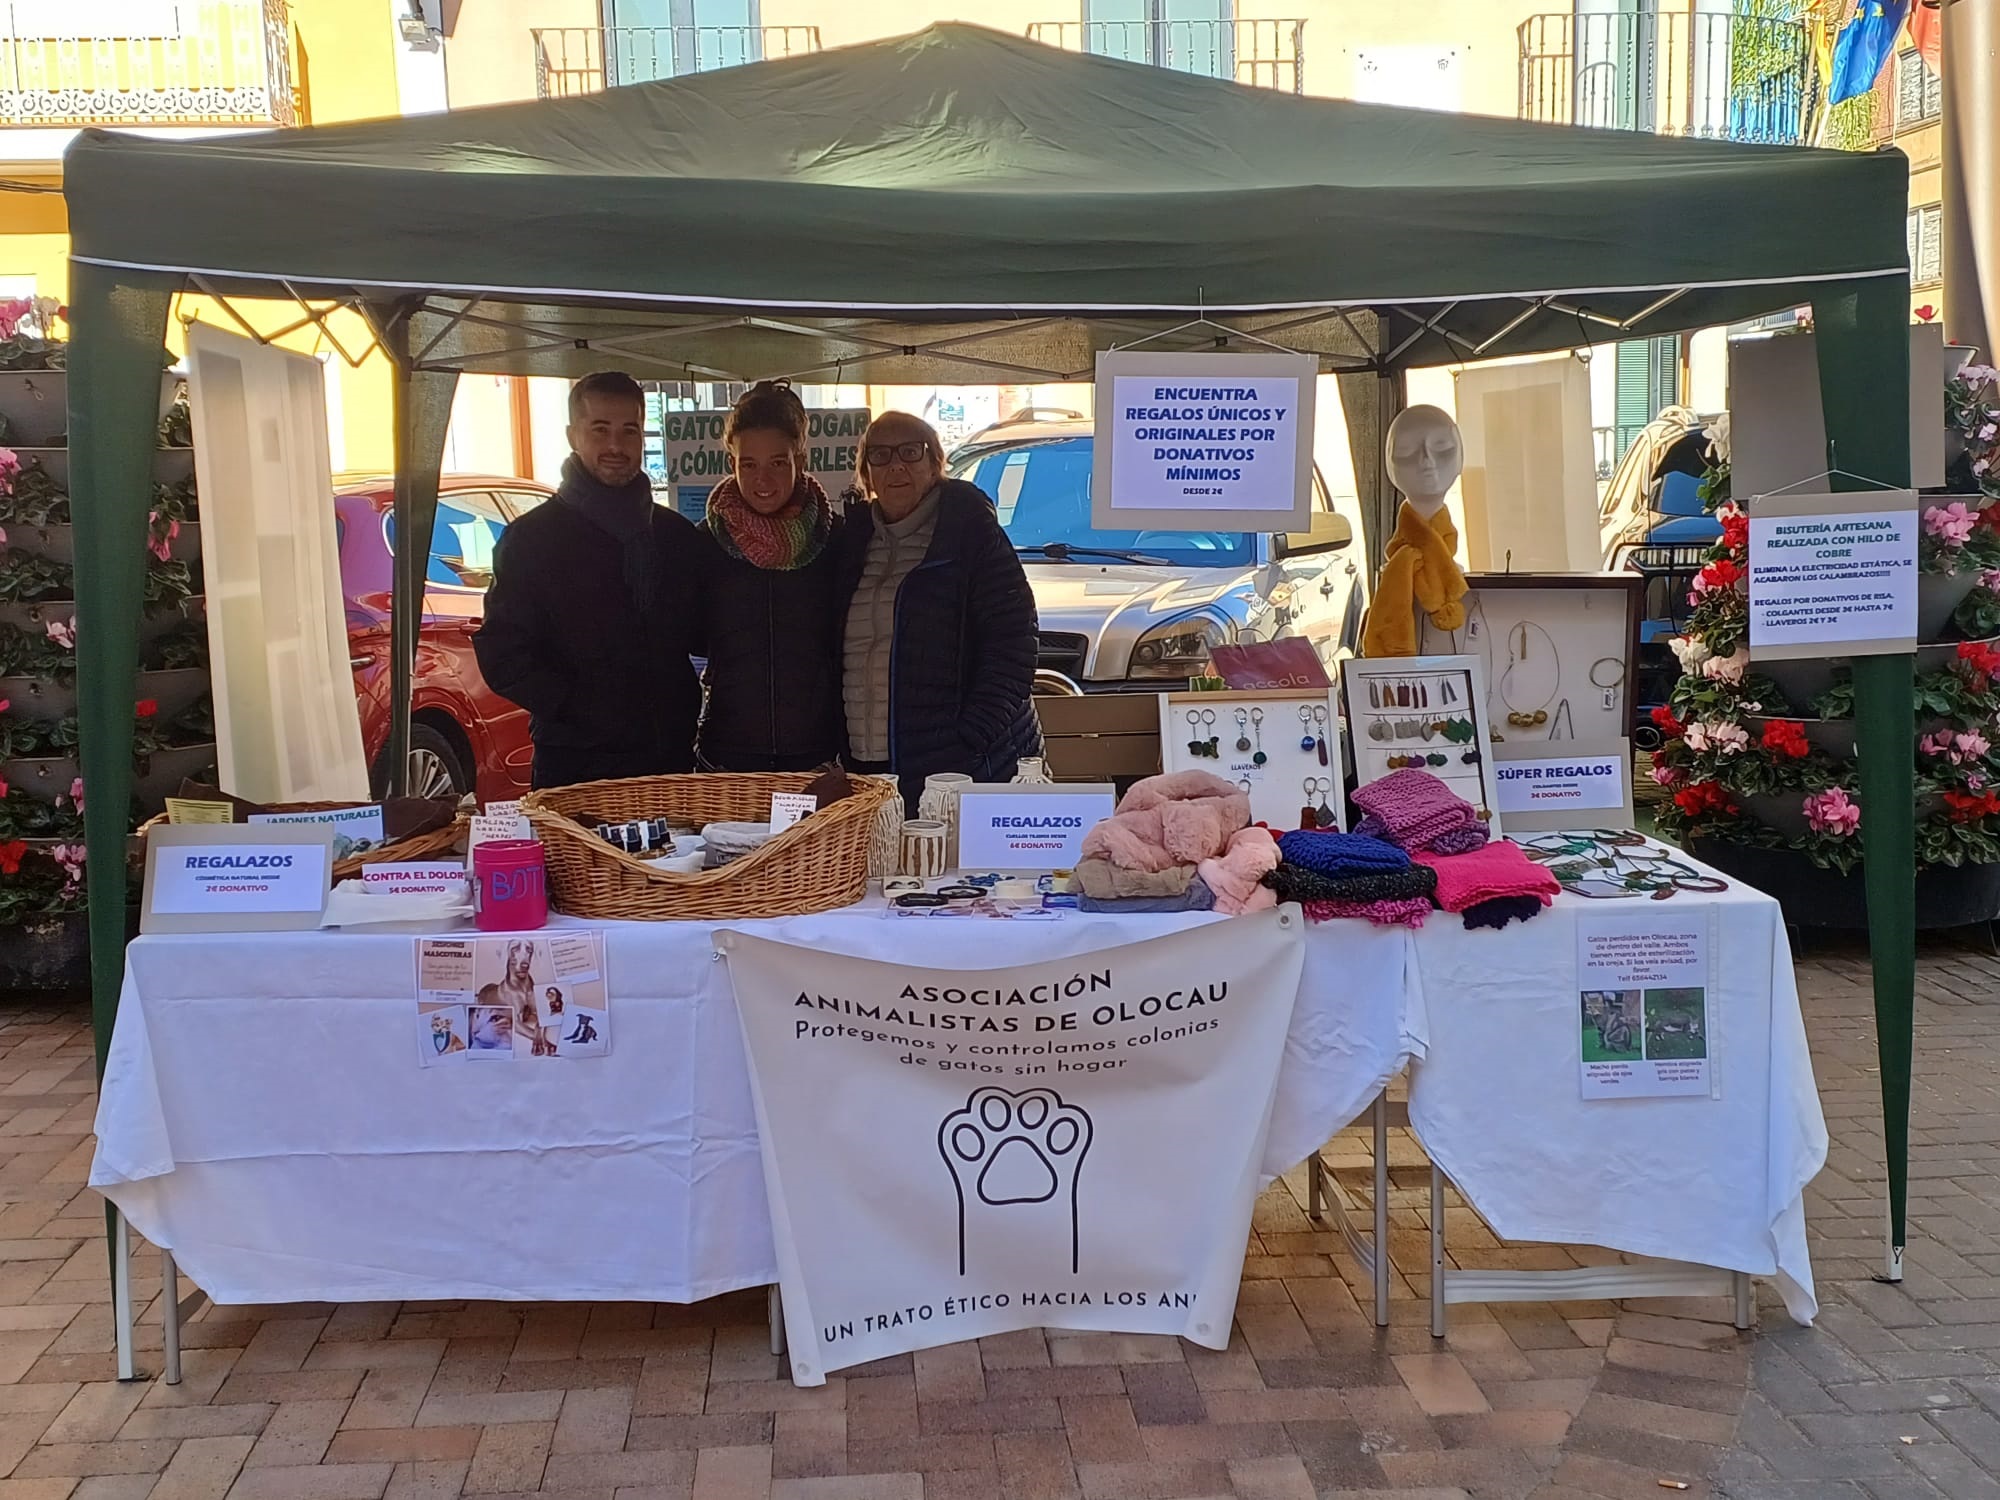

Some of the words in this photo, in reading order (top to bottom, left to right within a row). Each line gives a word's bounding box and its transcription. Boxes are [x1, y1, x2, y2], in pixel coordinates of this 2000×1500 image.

[1154, 388, 1258, 401] ENCUENTRA
[1125, 408, 1204, 421] REGALOS
[1207, 406, 1271, 421] ÚNICOS
[1275, 409, 1287, 421] Y
[666, 415, 725, 441] GATO
[808, 413, 869, 437] OGAR
[1134, 428, 1236, 441] ORIGINALES
[1240, 428, 1276, 441] POR
[804, 446, 858, 472] RLES
[1153, 448, 1255, 461] DONATIVOS
[1166, 465, 1241, 481] MÍNIMOS
[1775, 523, 1831, 535] BISUTERÍA
[1833, 521, 1892, 532] ARTESANA
[1767, 537, 1829, 548] REALIZADA
[1831, 536, 1855, 545] CON
[1857, 534, 1884, 544] HILO
[1886, 533, 1901, 542] DE
[1815, 549, 1852, 559] COBRE
[1753, 566, 1787, 574] ELIMINA
[1790, 565, 1800, 573] LA
[1802, 562, 1859, 572] ELECTRICIDAD
[1753, 575, 1801, 584] ACABARON
[1754, 597, 1792, 606] REGALOS
[1811, 594, 1859, 603] DONATIVOS
[1766, 608, 1813, 617] COLGANTES
[1815, 606, 1840, 614] DESDE
[1854, 604, 1881, 612] HASTA
[1766, 618, 1807, 627] LLAVEROS
[1497, 767, 1542, 780] SÚPER
[1546, 764, 1613, 778] REGALOS
[318, 809, 380, 823] NATURALES
[991, 817, 1082, 828] REGALAZOS
[185, 855, 293, 869] REGALAZOS
[364, 871, 412, 882] CONTRA
[413, 871, 427, 880] EL
[428, 870, 464, 880] DOLOR
[492, 865, 546, 901] BOT
[219, 884, 269, 892] DONATIVO
[401, 885, 446, 893] DONATIVO
[900, 969, 1113, 1007] ASOCIACIÓN
[794, 991, 1019, 1034] ANIMALISTAS
[1034, 1012, 1078, 1032] DE
[1092, 981, 1229, 1026] OLOCAU
[796, 1020, 936, 1051] Protegemos
[945, 1043, 959, 1054] y
[969, 1040, 1117, 1055] controlamos
[1126, 1017, 1220, 1048] colonias
[900, 1052, 928, 1067] de
[938, 1058, 1004, 1075] gatos
[1014, 1060, 1047, 1075] sin
[1057, 1056, 1129, 1075] hogar
[823, 1321, 855, 1343] UN
[864, 1304, 933, 1334] TRATO
[944, 1295, 1010, 1317] ÉTICO
[1022, 1292, 1092, 1306] HACIA
[1104, 1291, 1147, 1306] LOS
